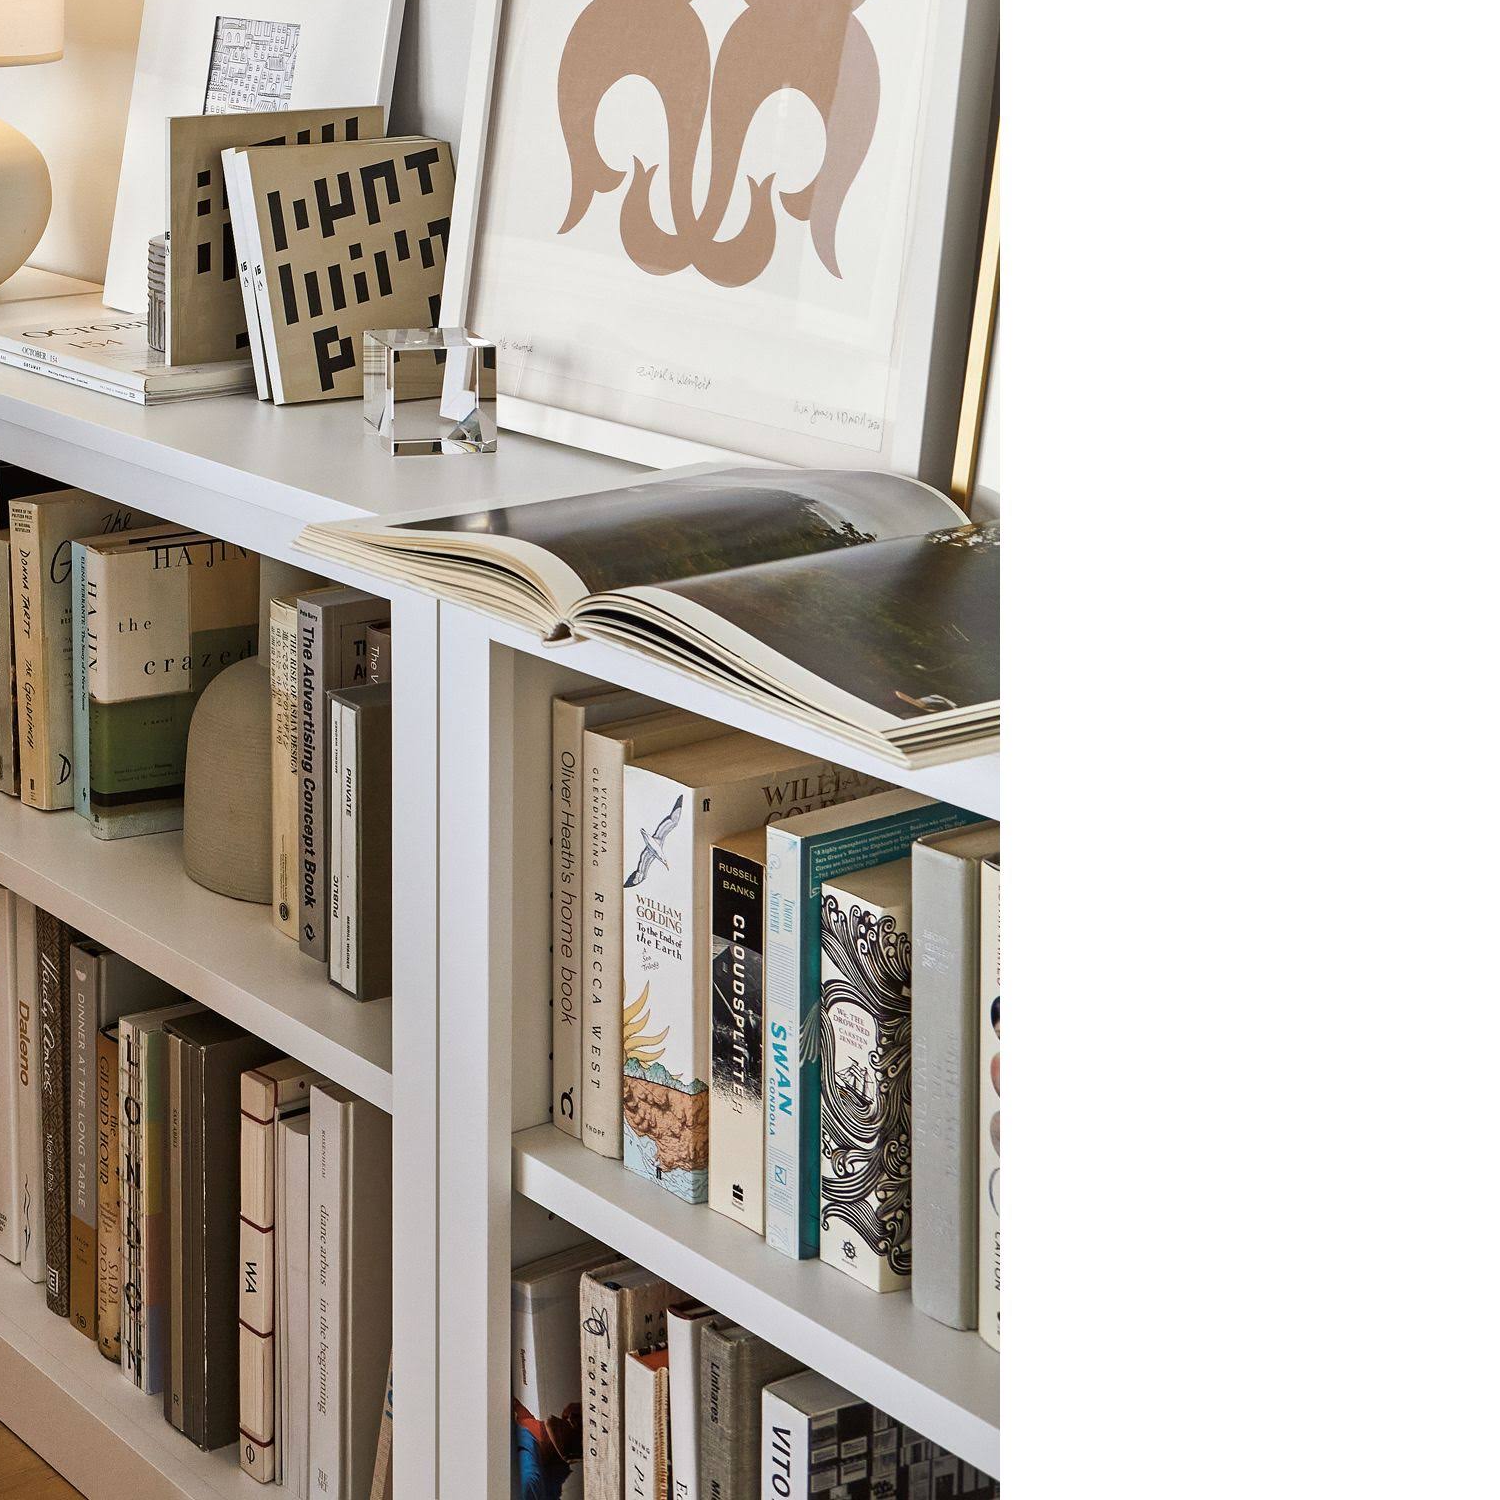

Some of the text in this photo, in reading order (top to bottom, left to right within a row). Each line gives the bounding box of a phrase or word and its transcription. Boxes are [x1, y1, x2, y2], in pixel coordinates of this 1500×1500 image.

[21, 346, 47, 362] OCTOBER
[100, 508, 133, 535] The
[152, 540, 250, 570] HA JIN
[87, 581, 98, 672] HA JIN
[118, 617, 152, 633] the
[18, 547, 36, 750] DONNA TARTT The GOLDFINCH
[143, 639, 252, 676] crazed
[290, 633, 298, 655] THE
[369, 645, 380, 671] The
[290, 657, 298, 682] RISE
[290, 701, 298, 735] ASIAN
[290, 735, 299, 776] DESIGN
[301, 627, 317, 910] The Advertising Concept Book
[592, 766, 600, 868] GLENDINNING
[600, 786, 609, 854] VICTORIA
[560, 750, 578, 1027] Oliver Heath's home book
[718, 861, 760, 886] RUSSELL
[722, 880, 756, 900] BANKS
[636, 893, 682, 921] WILLIAM
[636, 905, 682, 934] GOLDING
[636, 921, 646, 933] To
[647, 926, 659, 938] the
[659, 931, 675, 946] Ends
[636, 933, 682, 961] the Earth
[590, 891, 605, 1090] REBECCA WEST
[731, 913, 747, 1115] CLOUDSPLITTER
[833, 1014, 870, 1037] DROWNED
[18, 999, 31, 1088] Daleno
[838, 1027, 868, 1046] CARSTEN
[769, 1020, 793, 1117] SWAN
[77, 992, 87, 1209] DINNER AT THE LONG TABLE
[768, 1077, 776, 1137] GONDOLA
[99, 1055, 110, 1186] GILDED HOUR
[109, 1114, 119, 1137] the
[585, 1123, 606, 1138] KNOPF
[107, 1260, 119, 1306] SARA
[244, 1260, 258, 1295] WA
[316, 1203, 329, 1416] diane arbus in the beginning
[587, 1355, 598, 1458] CORNEJO
[599, 1360, 609, 1435] MARIA
[710, 1361, 721, 1425] Linhares
[631, 1445, 648, 1460] WITH
[771, 1425, 792, 1499] VITO
